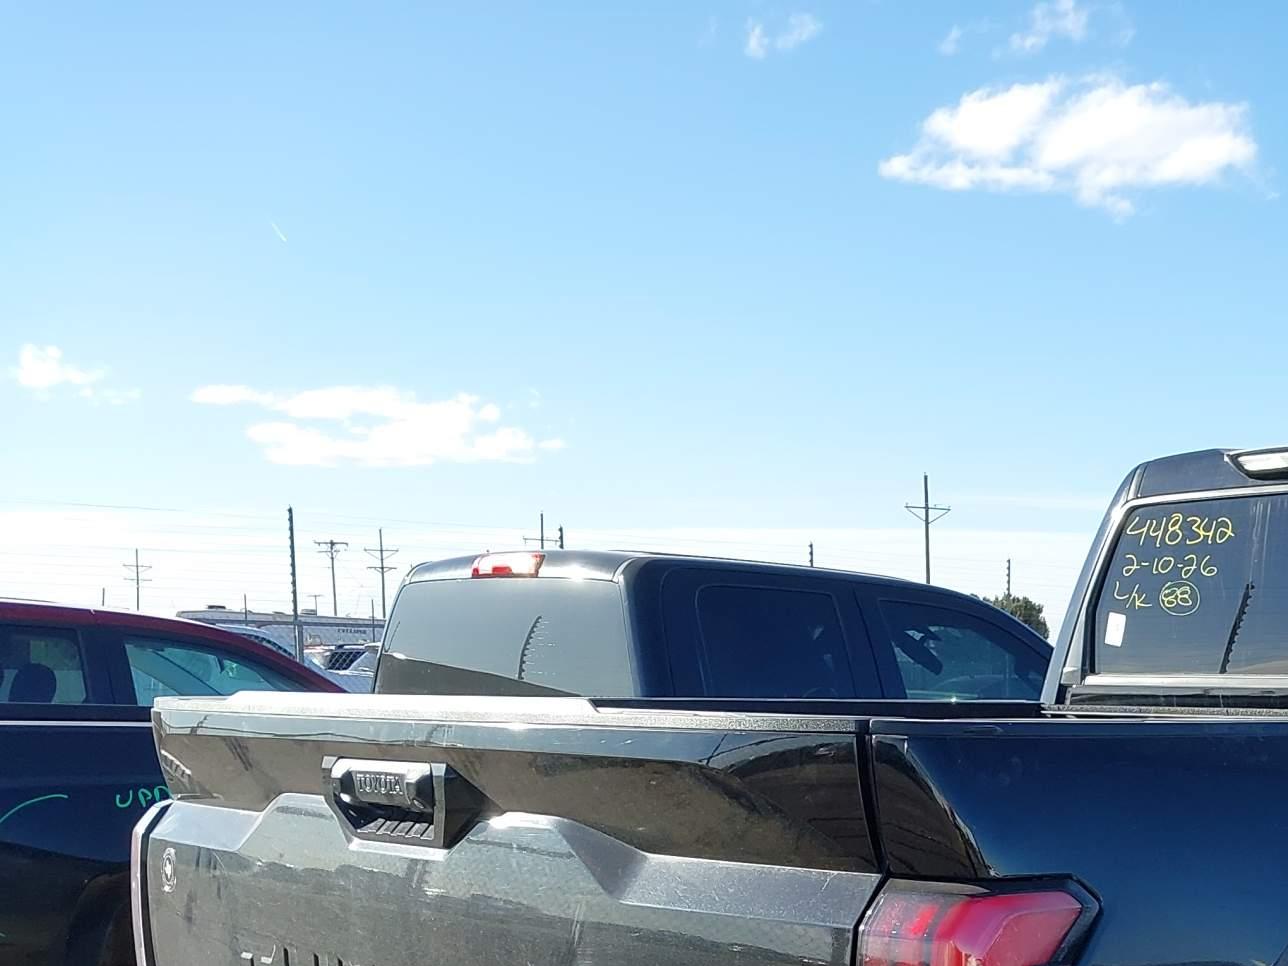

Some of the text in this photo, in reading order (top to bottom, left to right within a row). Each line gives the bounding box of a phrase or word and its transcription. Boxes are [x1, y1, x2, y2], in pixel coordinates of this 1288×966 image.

[1126, 513, 1235, 547] 448342
[1122, 554, 1218, 579] 2-10-26
[356, 774, 404, 795] TOYOTA
